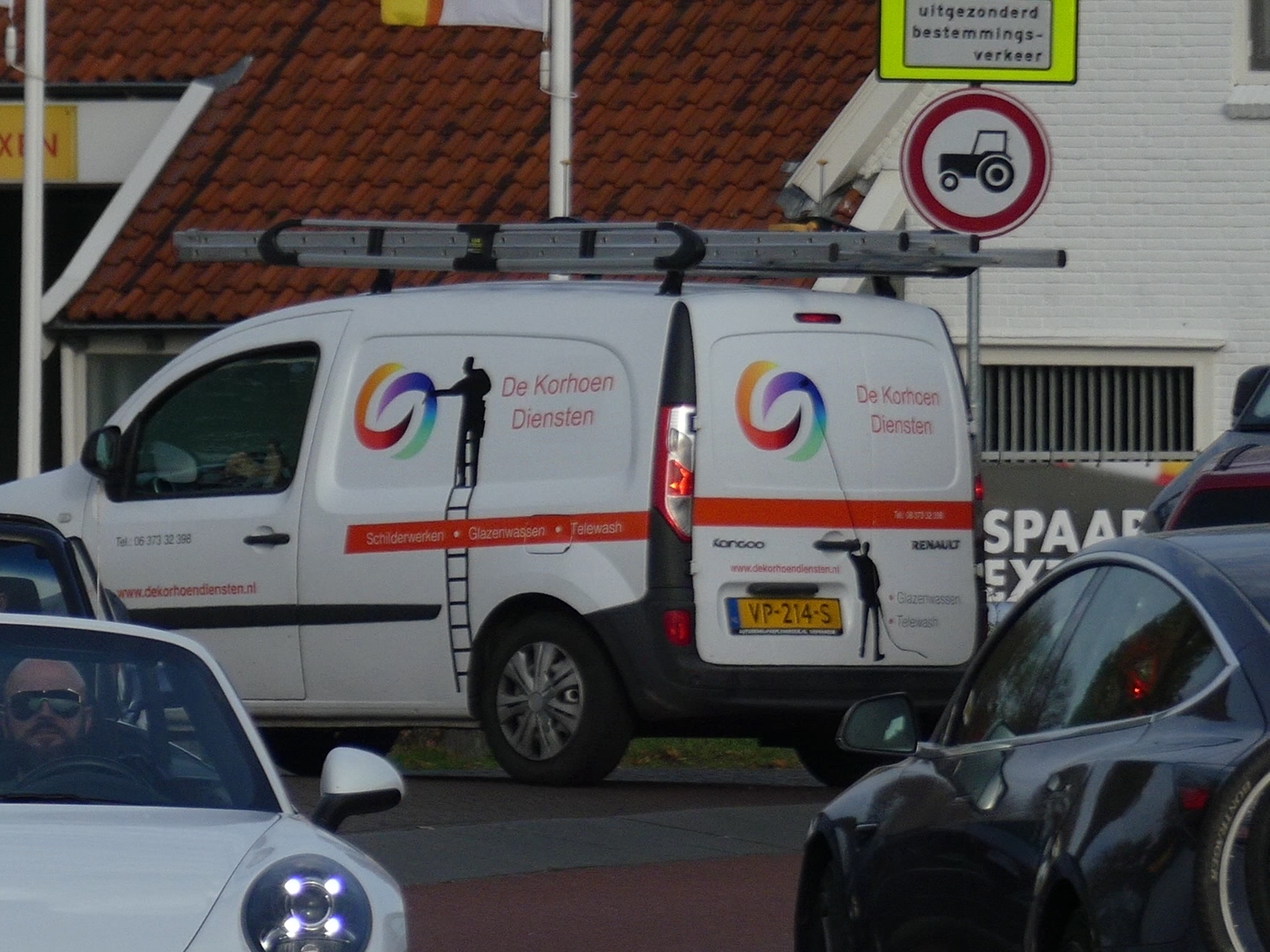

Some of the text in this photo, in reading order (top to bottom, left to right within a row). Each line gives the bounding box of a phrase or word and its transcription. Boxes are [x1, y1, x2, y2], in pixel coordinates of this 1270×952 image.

[918, 5, 1039, 21] uitgezonderd
[912, 25, 1043, 43] bestemmings-
[973, 49, 1043, 62] verkeer
[501, 373, 614, 397] De Korhoen
[856, 385, 940, 406] De Korhoen
[511, 408, 595, 430] Diensten
[871, 414, 933, 434] Diensten
[134, 535, 145, 546] 06
[146, 535, 162, 545] 373
[164, 534, 175, 545] 32
[175, 533, 192, 544] 398
[366, 520, 623, 546] Schilderwerken Glazenwassen Telewash
[911, 540, 960, 550] RENAULT
[730, 563, 841, 575] www.dekorhoendiensten.nl
[985, 559, 1063, 602] EX
[116, 582, 257, 599] www.dekorhoendiensten.nl
[748, 603, 831, 624] VP-214-S
